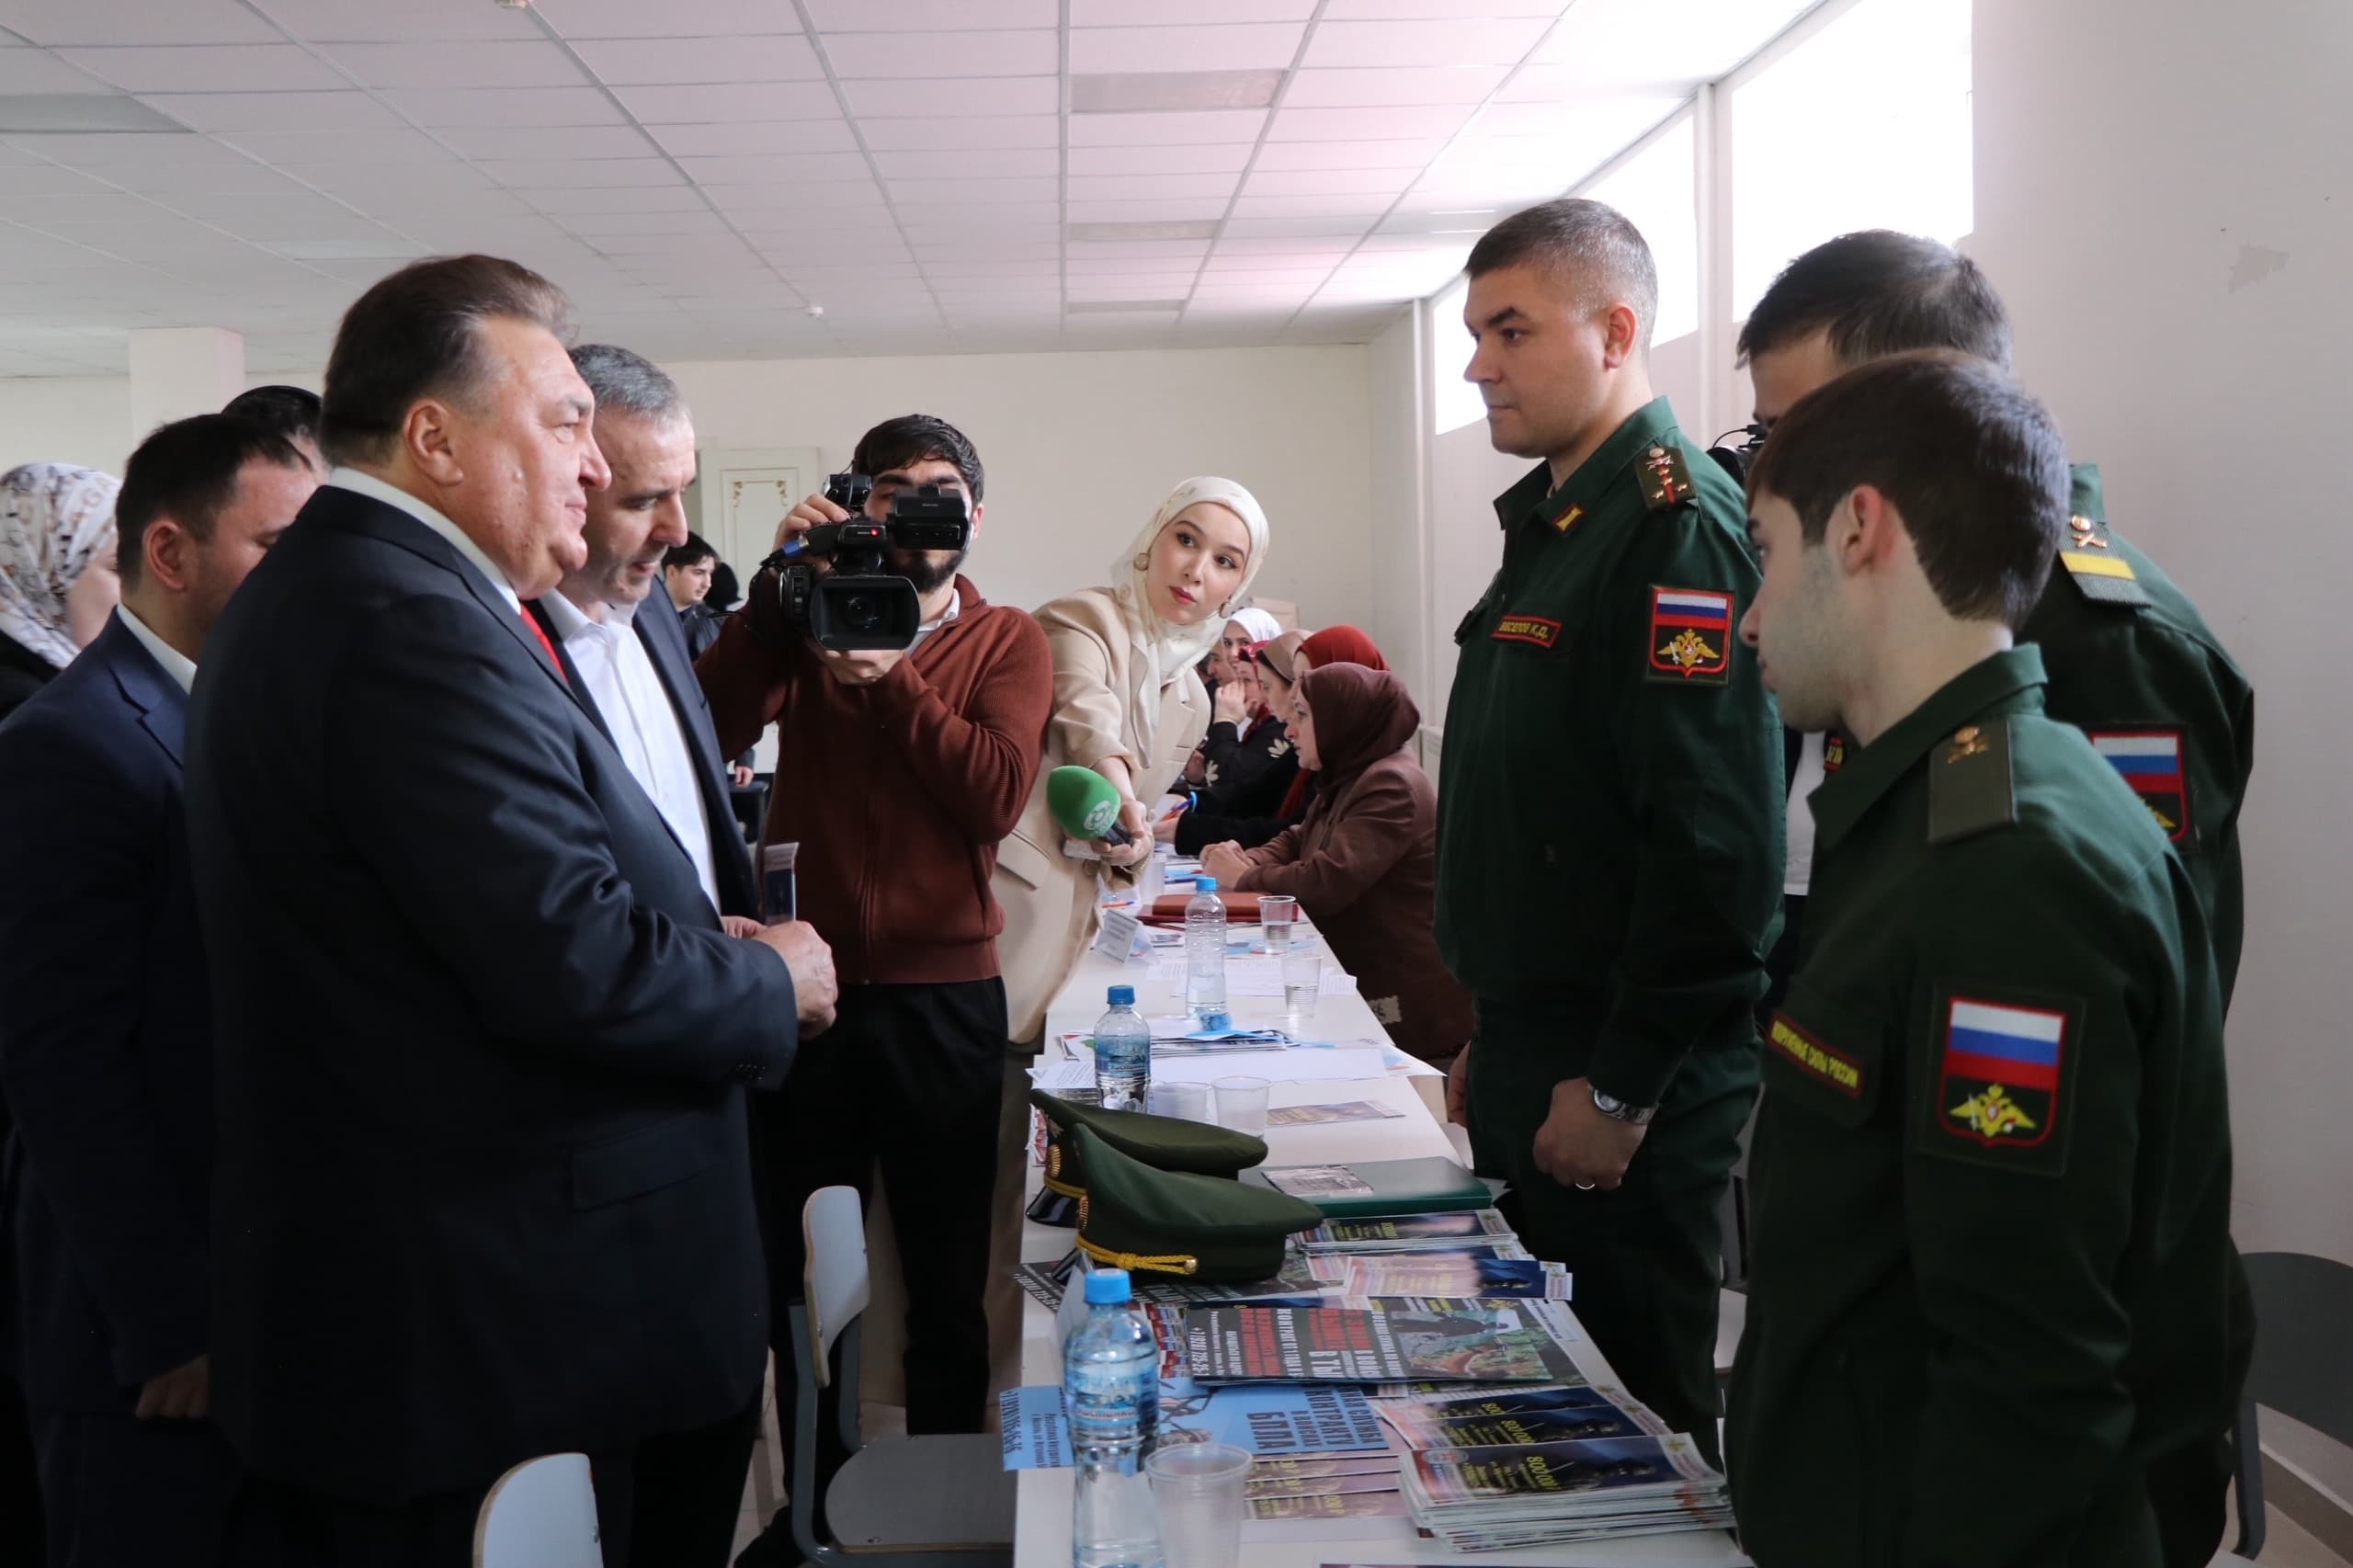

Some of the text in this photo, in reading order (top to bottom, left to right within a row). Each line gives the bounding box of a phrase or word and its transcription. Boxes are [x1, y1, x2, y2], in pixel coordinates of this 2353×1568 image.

[1246, 1412, 1297, 1450] БПЛА
[1304, 1391, 1356, 1446] КОНТРАКТУ
[1347, 1409, 1385, 1444] СЛУЖБА
[1527, 1456, 1549, 1474] 800
